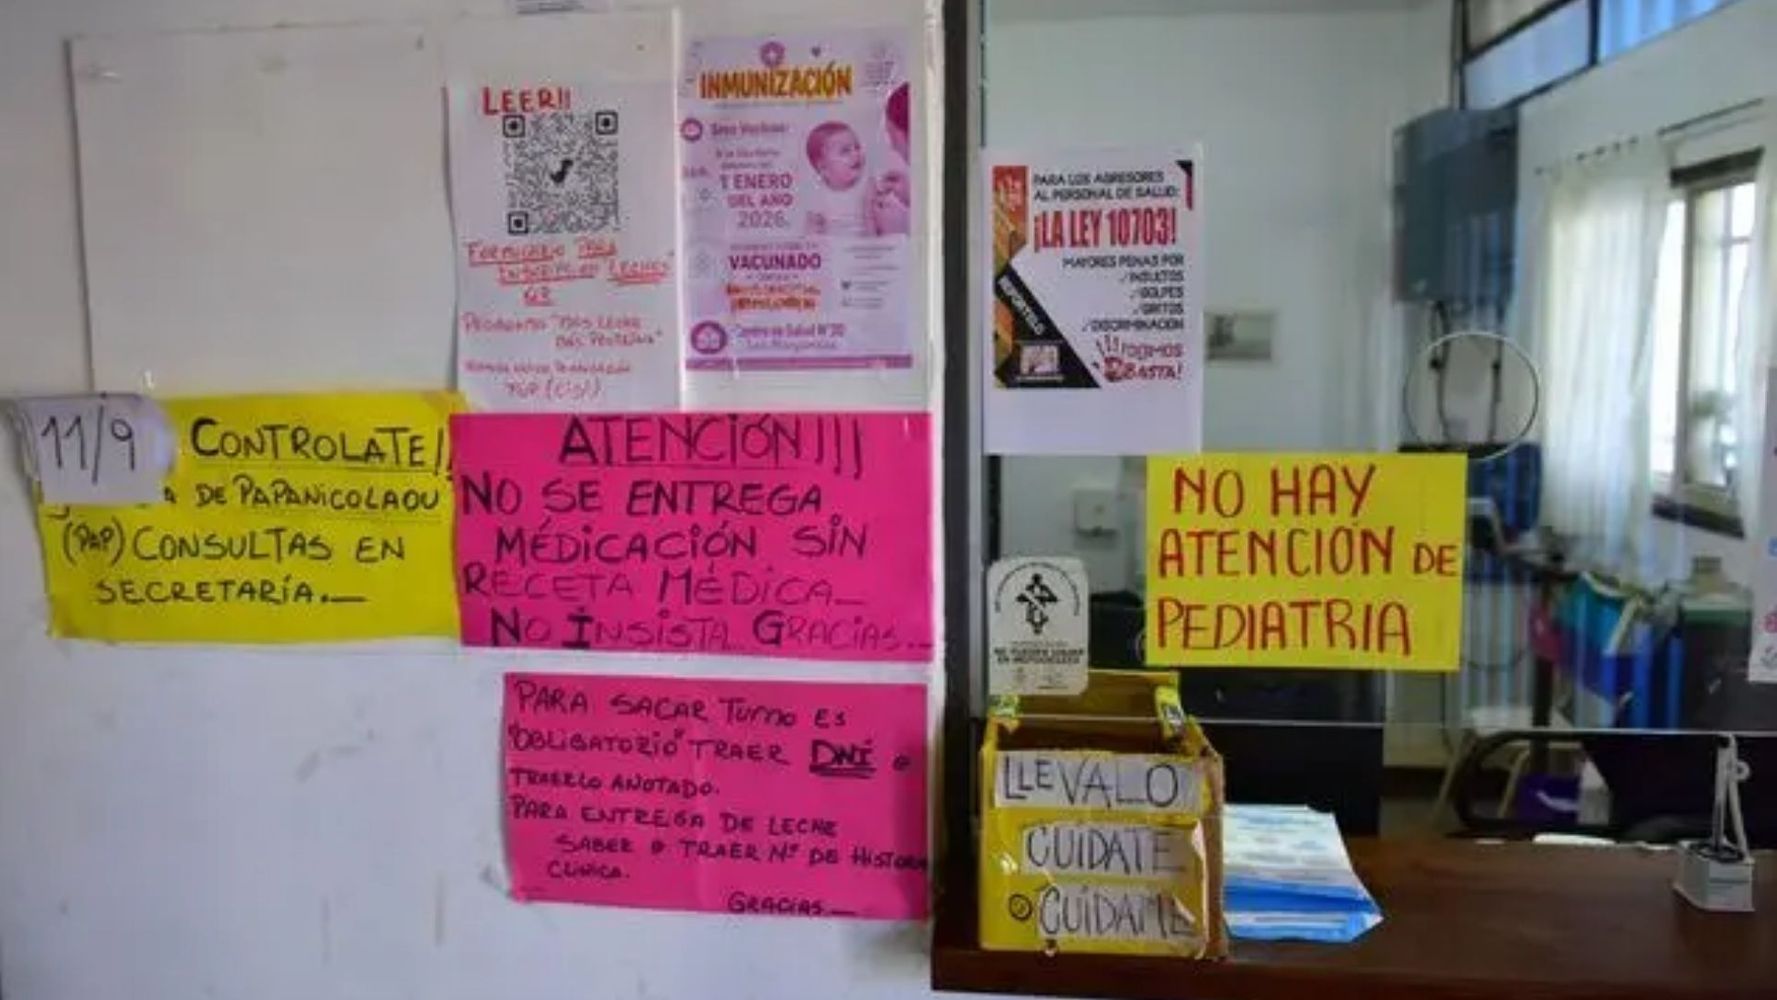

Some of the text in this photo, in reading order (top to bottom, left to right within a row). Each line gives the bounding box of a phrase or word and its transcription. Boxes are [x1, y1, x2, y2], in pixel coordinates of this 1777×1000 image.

[699, 60, 853, 99] INMUNIZACIÓN
[733, 173, 794, 190] ENERO
[1032, 169, 1165, 187] PARA LOS AGRESORES
[1033, 187, 1051, 201] AL
[1052, 187, 1114, 201] PERSONAL
[1116, 186, 1133, 200] DE
[726, 195, 758, 209] DEL
[1033, 206, 1178, 253] ¡LA LEY 10703!
[728, 253, 823, 271] VACUNADO
[1062, 254, 1185, 269] MAYORES PENAS POR
[1139, 286, 1185, 299] GOLPES
[1141, 302, 1185, 316] GRITOS
[40, 403, 136, 486] 11/9
[195, 484, 229, 506] DE
[231, 474, 440, 513] PAPANICOLAOU
[461, 471, 822, 517] NO SE ENTREGA
[1174, 462, 1377, 519] NO HAY
[133, 525, 333, 562] CONSULTAS
[355, 536, 405, 564] EN
[1412, 542, 1460, 578] DE
[463, 561, 634, 598] RECETA
[490, 608, 552, 646] NO
[1157, 596, 1412, 658] PEDIATRIA
[514, 680, 588, 715] PARA
[609, 692, 709, 722] SACAR
[687, 738, 791, 766] TRAER
[1004, 755, 1179, 809] LLEVALO
[510, 794, 840, 838] PARA ENTREGA DE LECHE
[554, 833, 634, 855] SABER
[678, 840, 761, 863] TRAER
[808, 848, 841, 867] DE
[1026, 825, 1188, 876] CUIDATE
